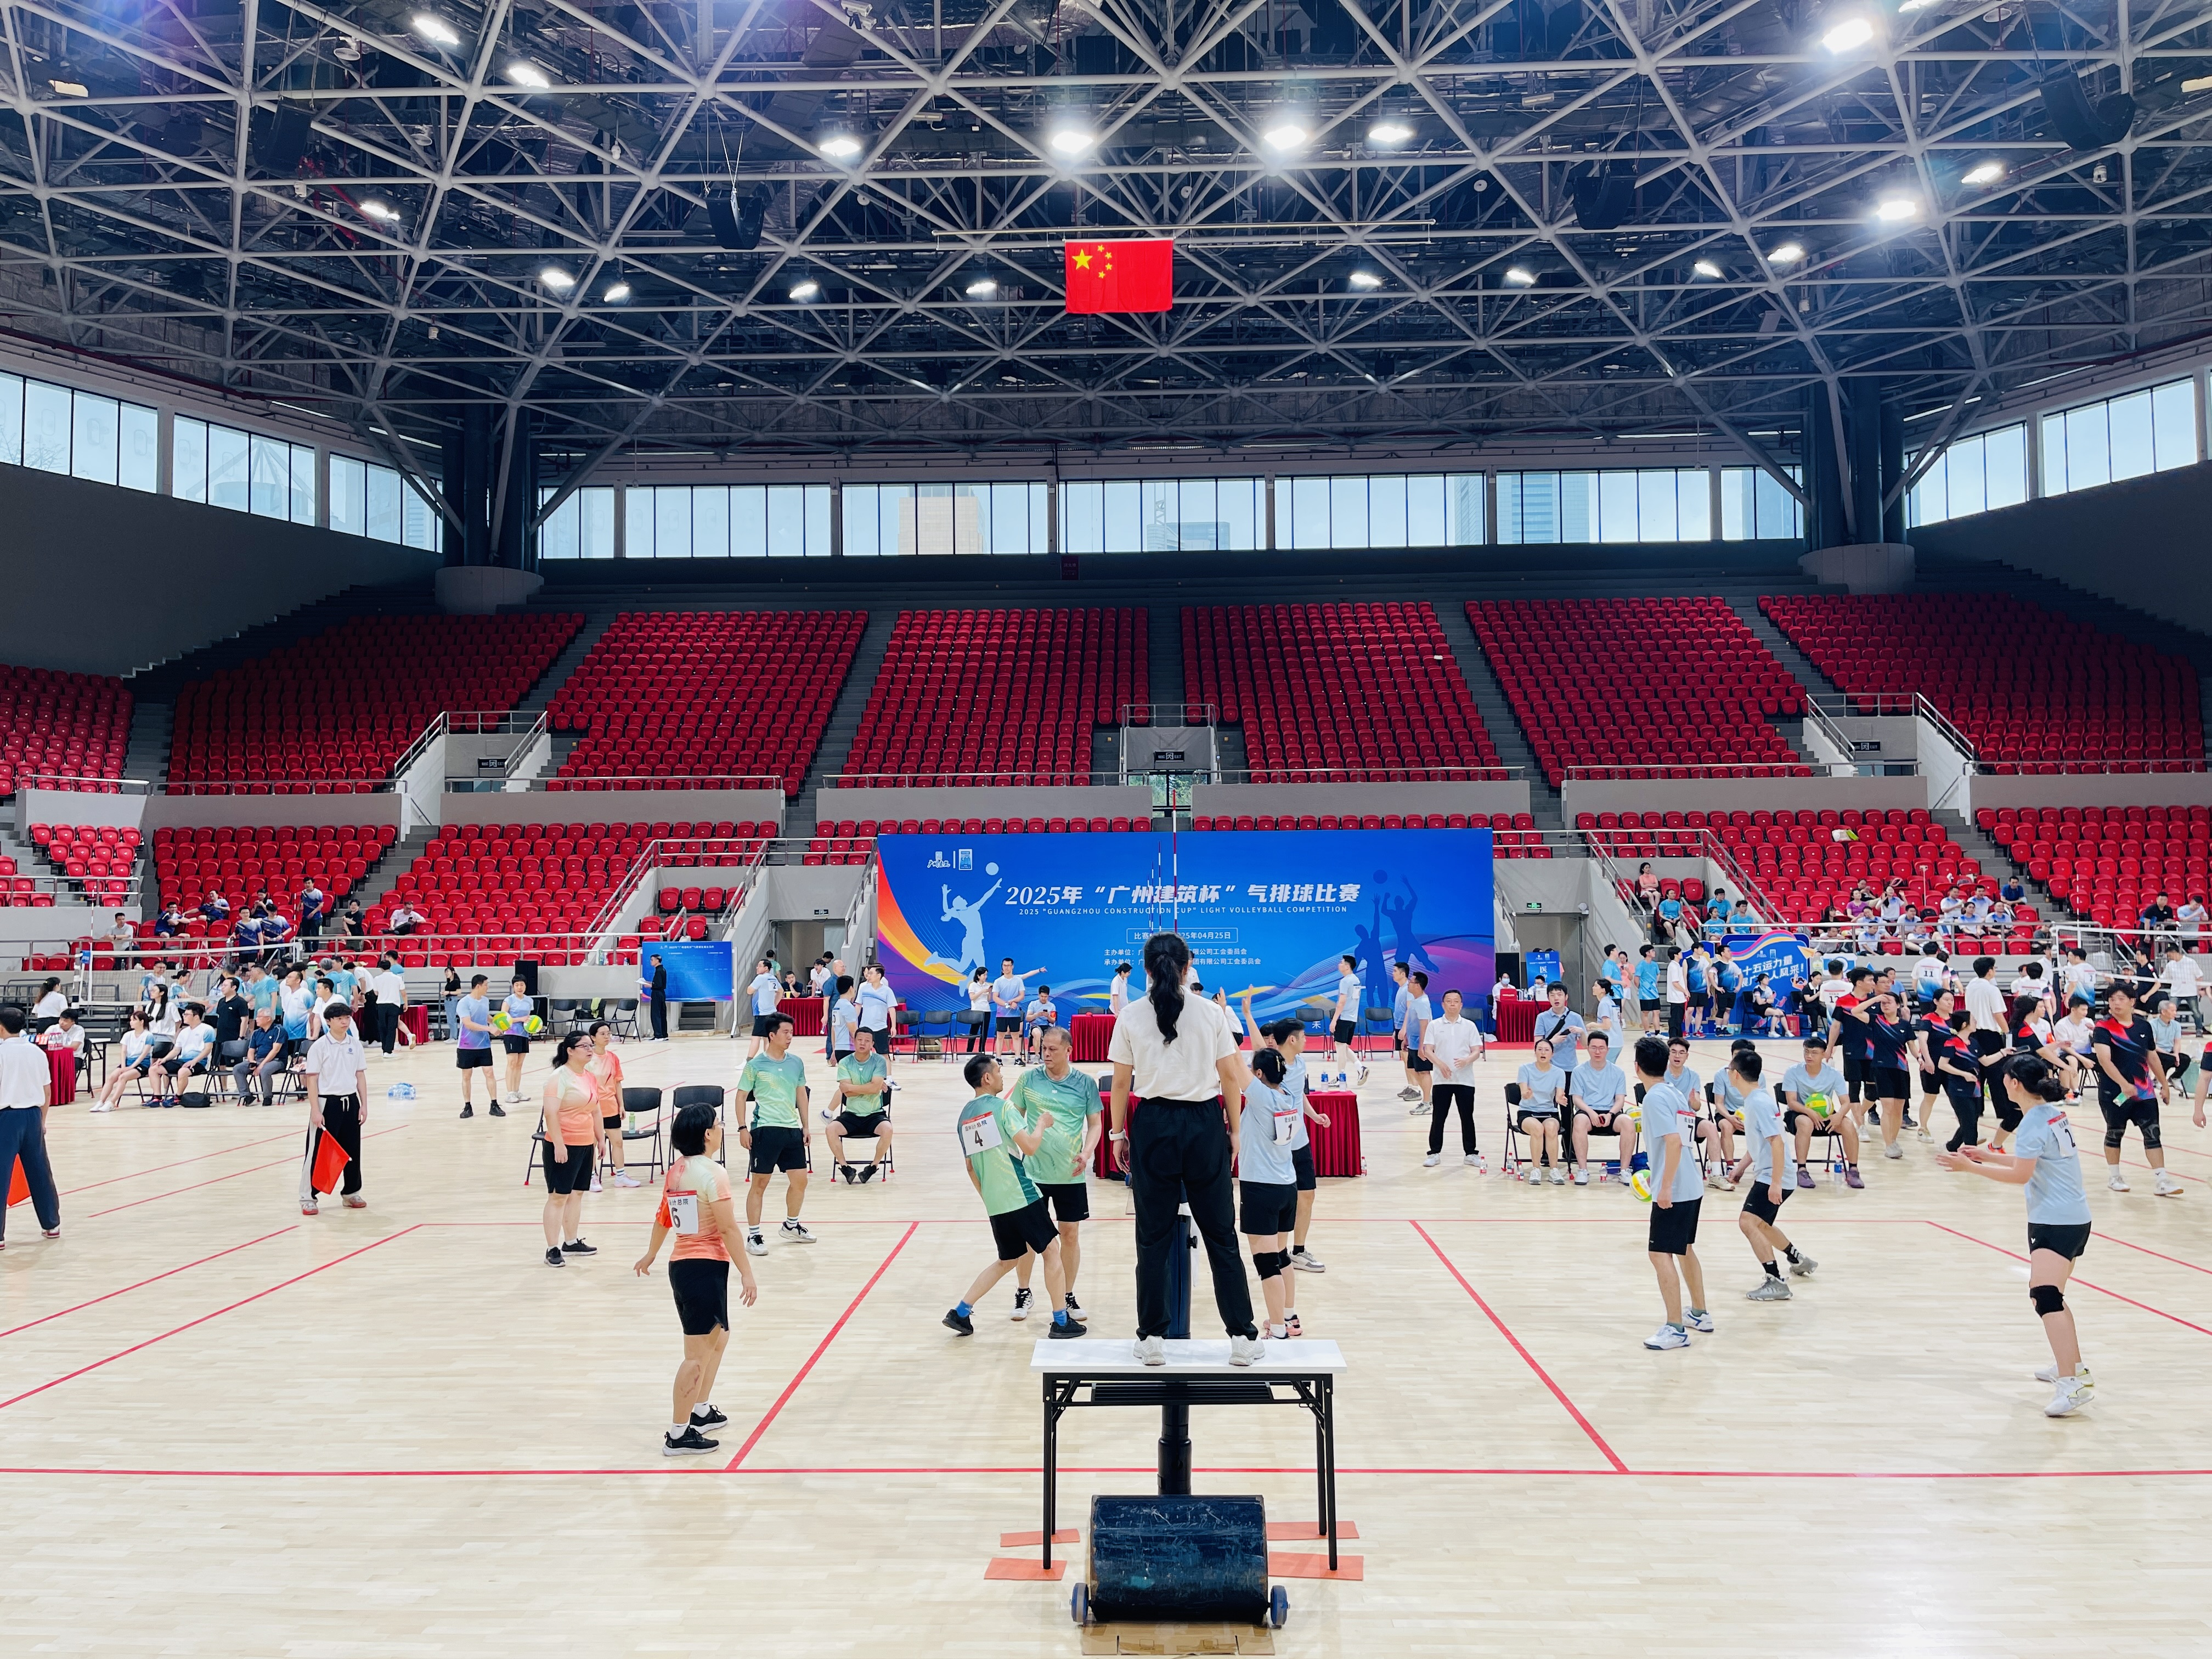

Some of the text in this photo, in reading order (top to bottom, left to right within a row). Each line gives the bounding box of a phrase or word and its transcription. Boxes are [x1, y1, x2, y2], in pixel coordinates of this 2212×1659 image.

[975, 1130, 983, 1147] 4
[1688, 1125, 1694, 1142] 7
[671, 1207, 681, 1228] 6
